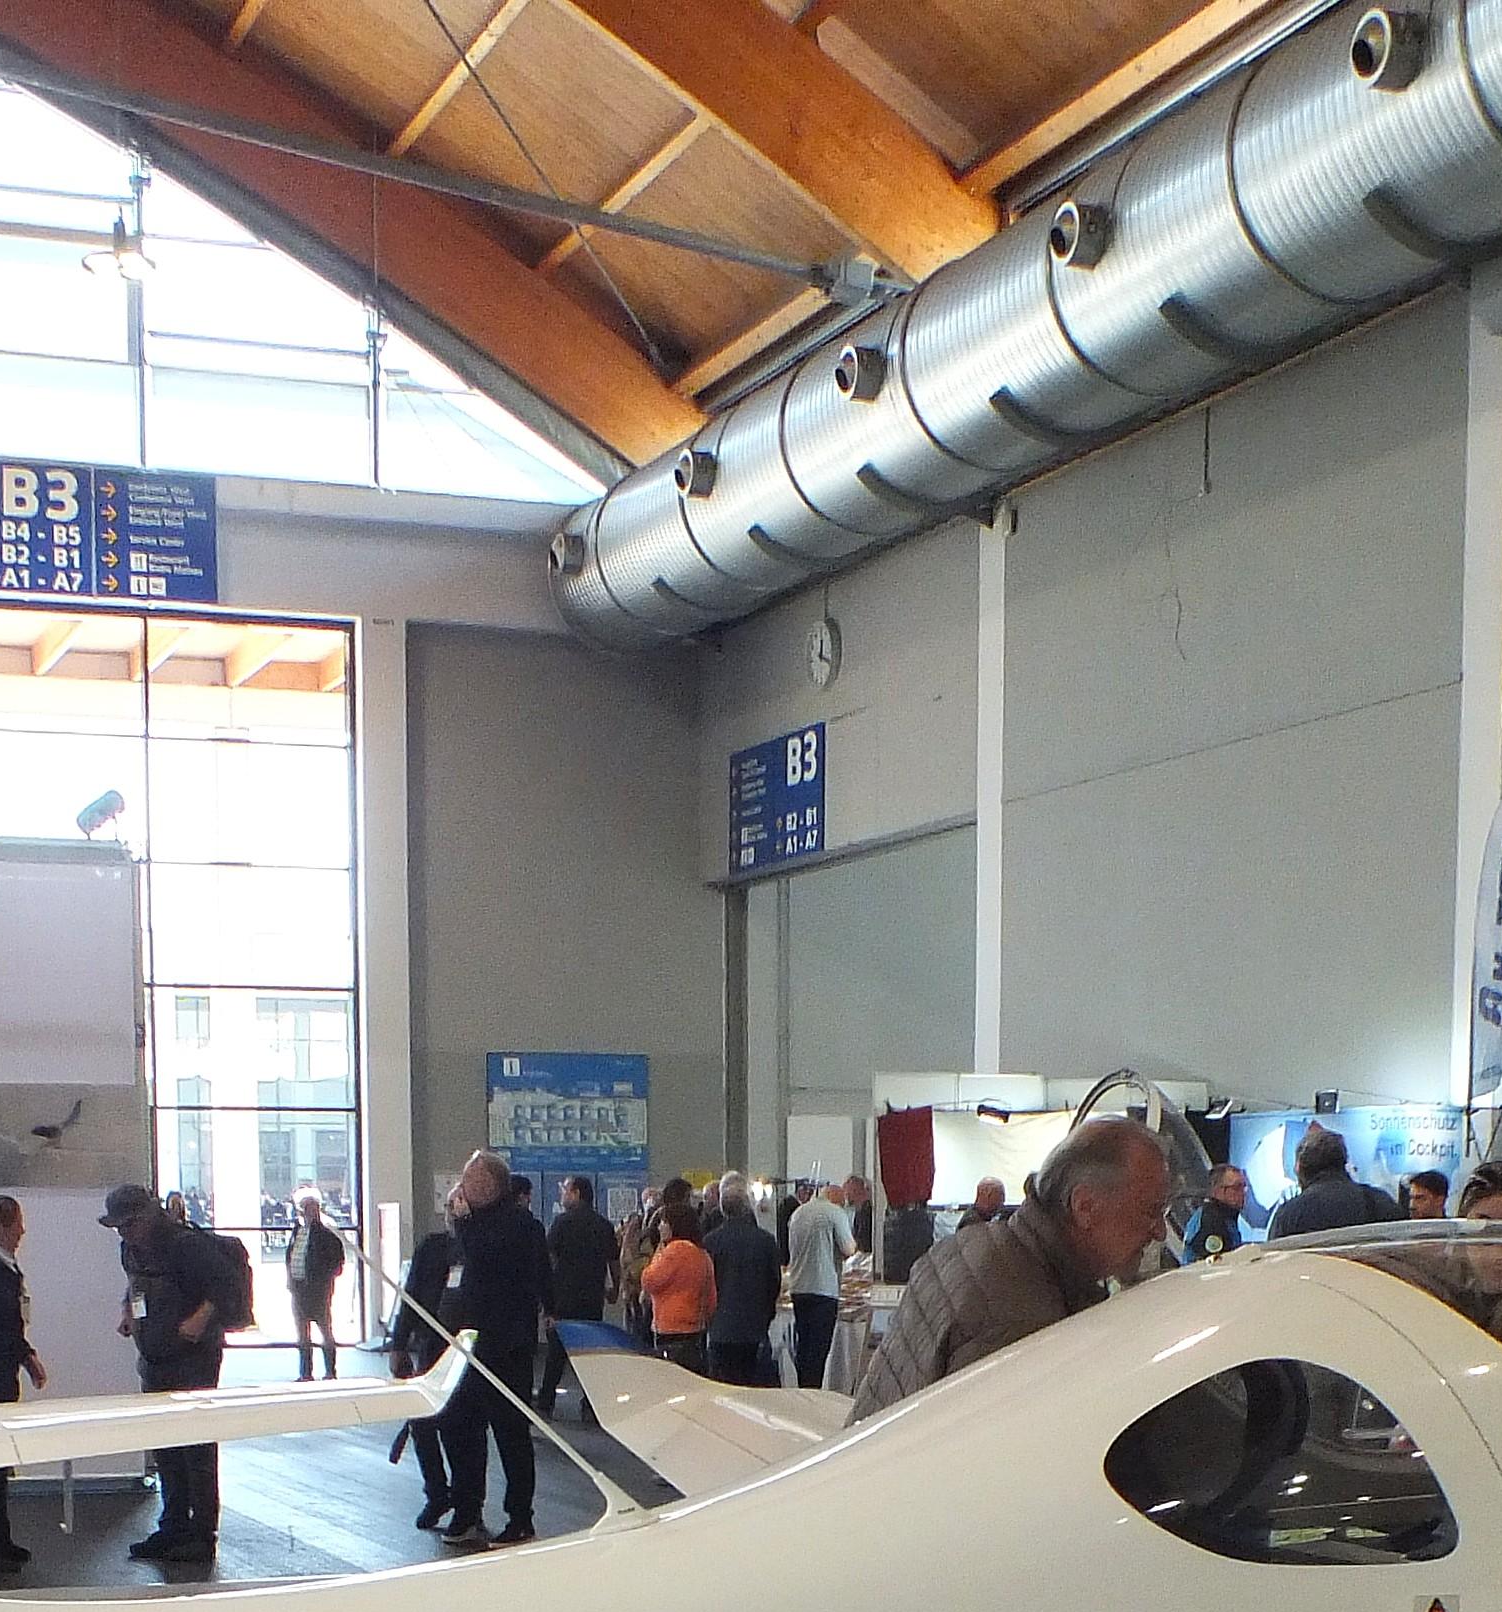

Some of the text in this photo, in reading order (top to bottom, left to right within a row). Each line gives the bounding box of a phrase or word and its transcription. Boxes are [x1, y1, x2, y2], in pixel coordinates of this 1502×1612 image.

[2, 467, 79, 521] B3
[1, 521, 30, 542] B4
[52, 524, 81, 546] B5
[1, 544, 30, 565] B2
[52, 547, 81, 569] B1
[1, 568, 31, 589] A1
[52, 571, 83, 592] A7
[786, 730, 817, 786] B3
[786, 811, 797, 832] B2
[785, 835, 798, 855] A1
[804, 829, 818, 850] A7
[1370, 1113, 1458, 1131] Sonnenschutz
